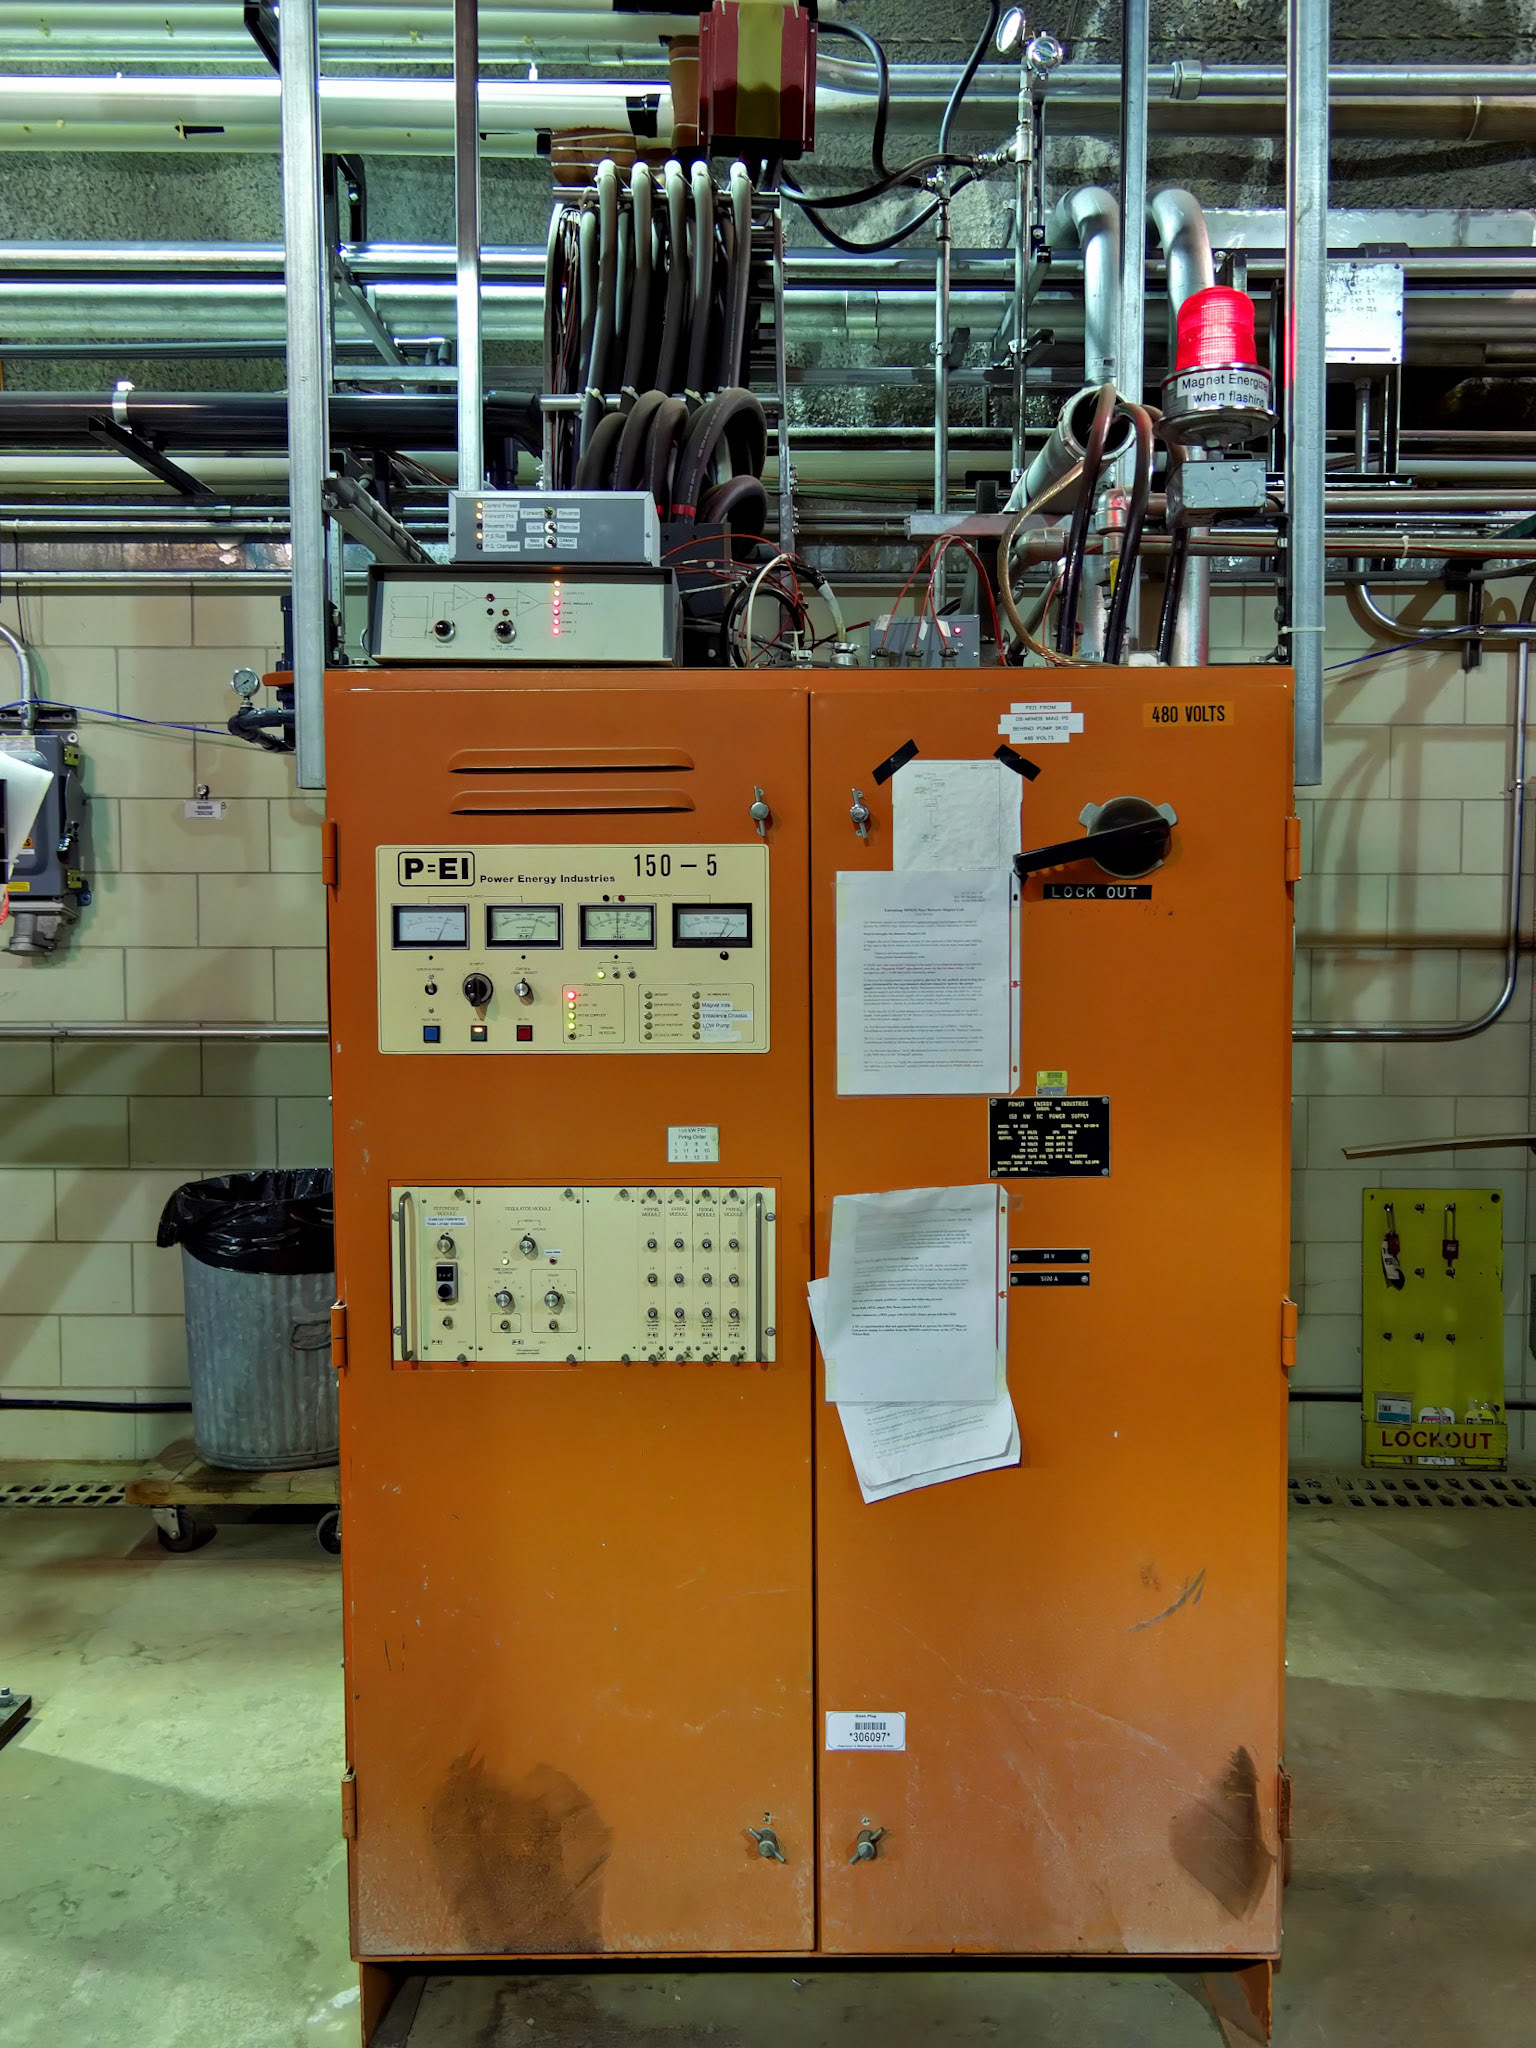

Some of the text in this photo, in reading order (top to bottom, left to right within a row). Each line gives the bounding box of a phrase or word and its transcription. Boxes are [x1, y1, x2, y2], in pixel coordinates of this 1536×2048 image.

[1182, 374, 1225, 390] Magnet
[1193, 391, 1265, 408] when flashing
[1152, 705, 1225, 723] 480 VOLTS
[634, 854, 671, 877] 150
[706, 854, 717, 876] 5
[480, 874, 616, 884] Power Energy Industries
[1052, 886, 1138, 898] LOCK OUT
[1382, 1431, 1493, 1450] LOCKOUT
